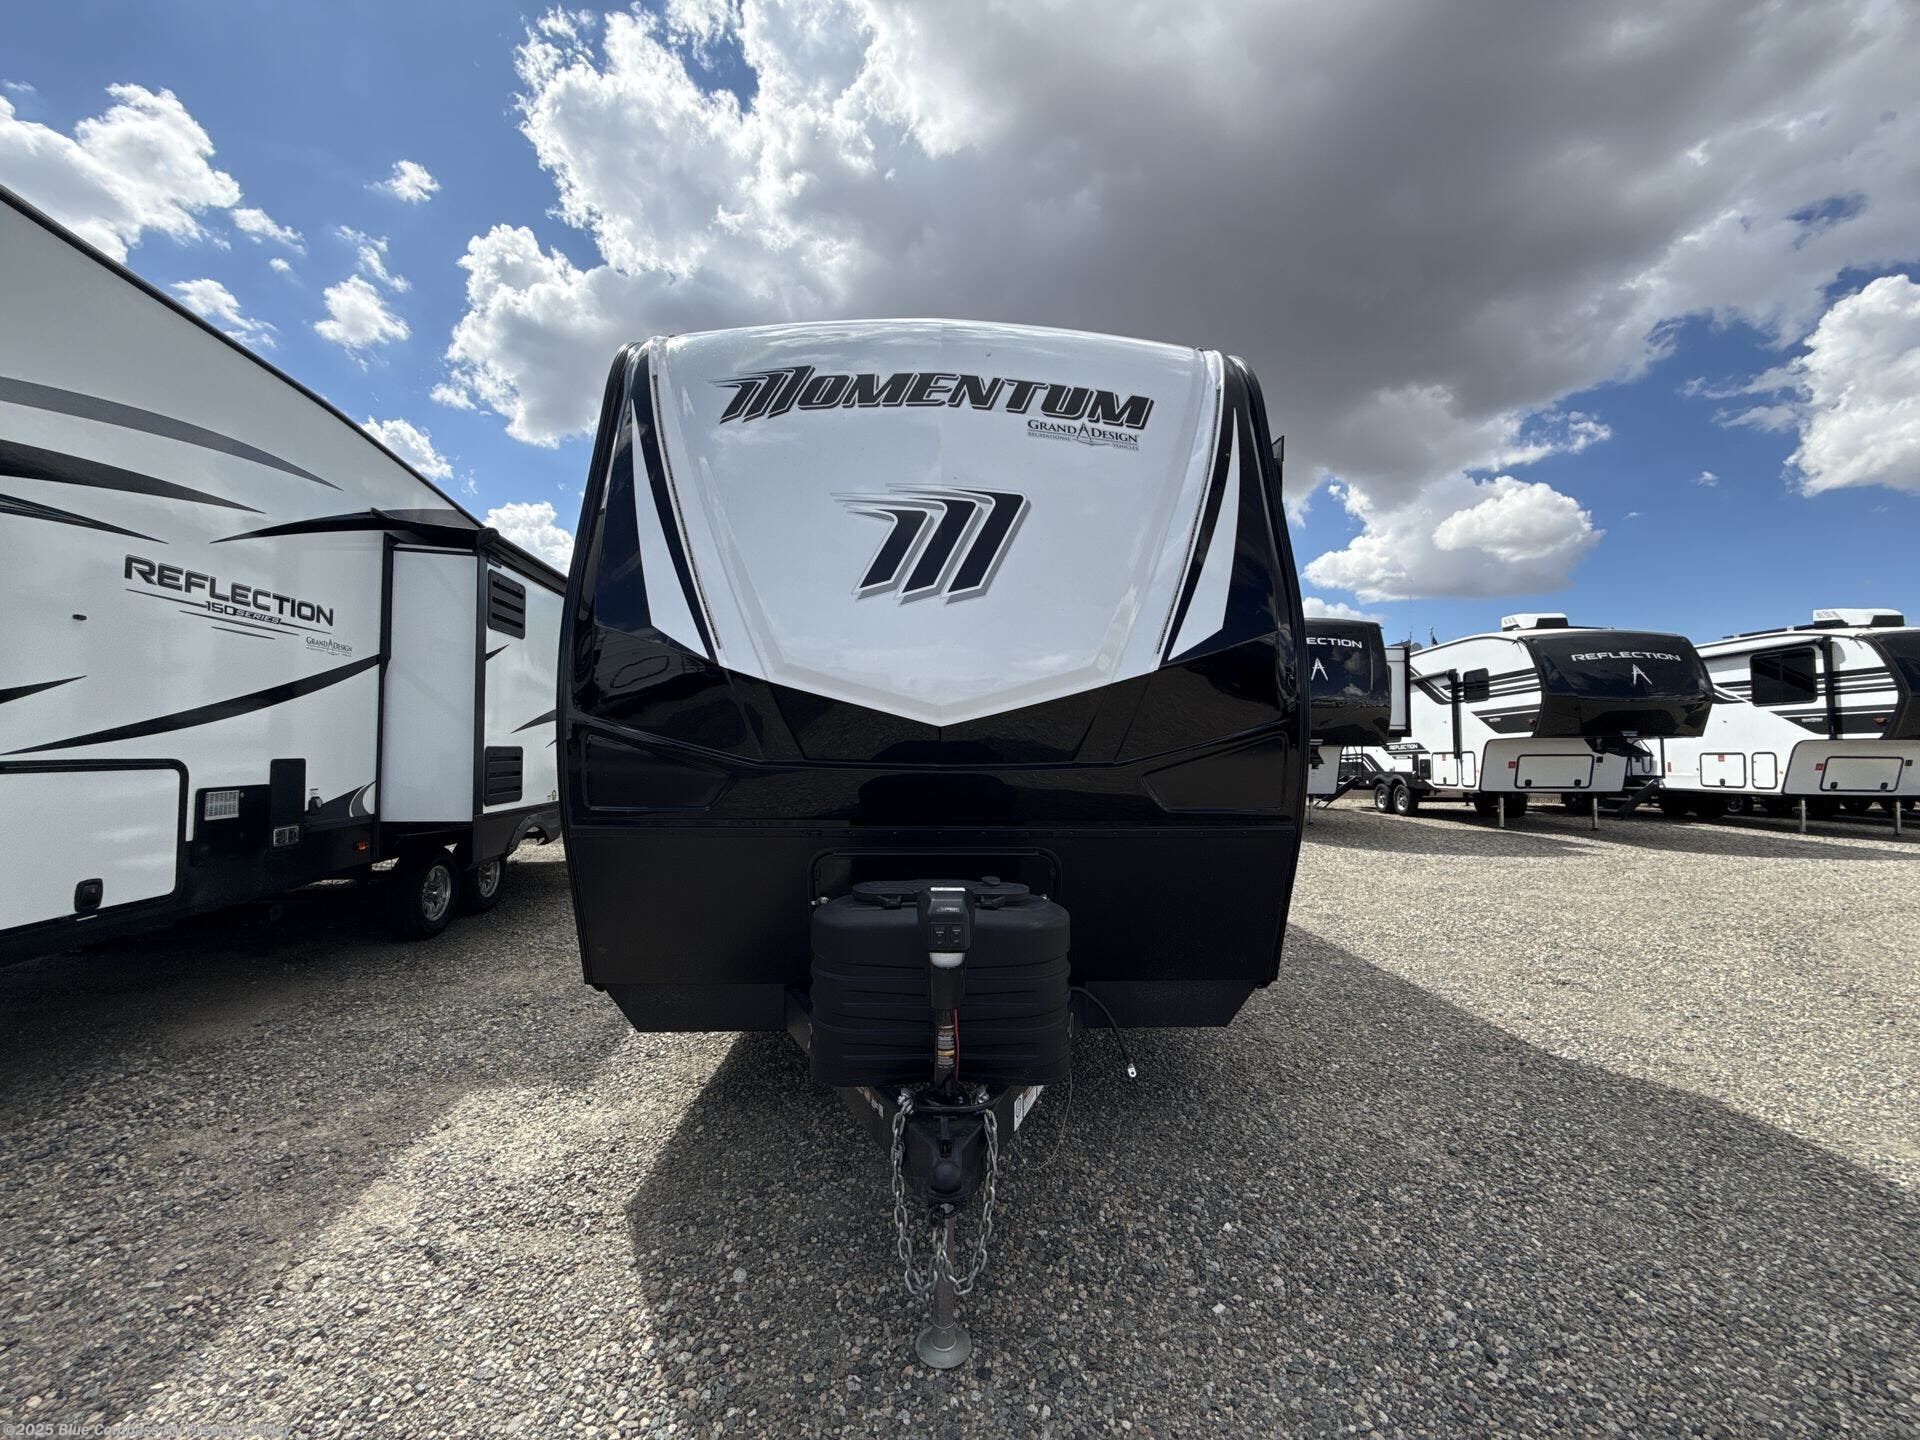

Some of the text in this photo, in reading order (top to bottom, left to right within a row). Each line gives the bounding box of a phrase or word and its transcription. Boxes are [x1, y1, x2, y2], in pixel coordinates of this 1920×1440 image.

[708, 365, 1155, 430] MOMENTUM
[1027, 419, 1138, 443] GRAND DESIGN
[124, 554, 335, 627] REFLECTION
[206, 600, 282, 625] 150 SERIES
[306, 636, 328, 647] GRAND
[1306, 637, 1362, 649] ECTION
[1571, 651, 1681, 661] REFLECTION
